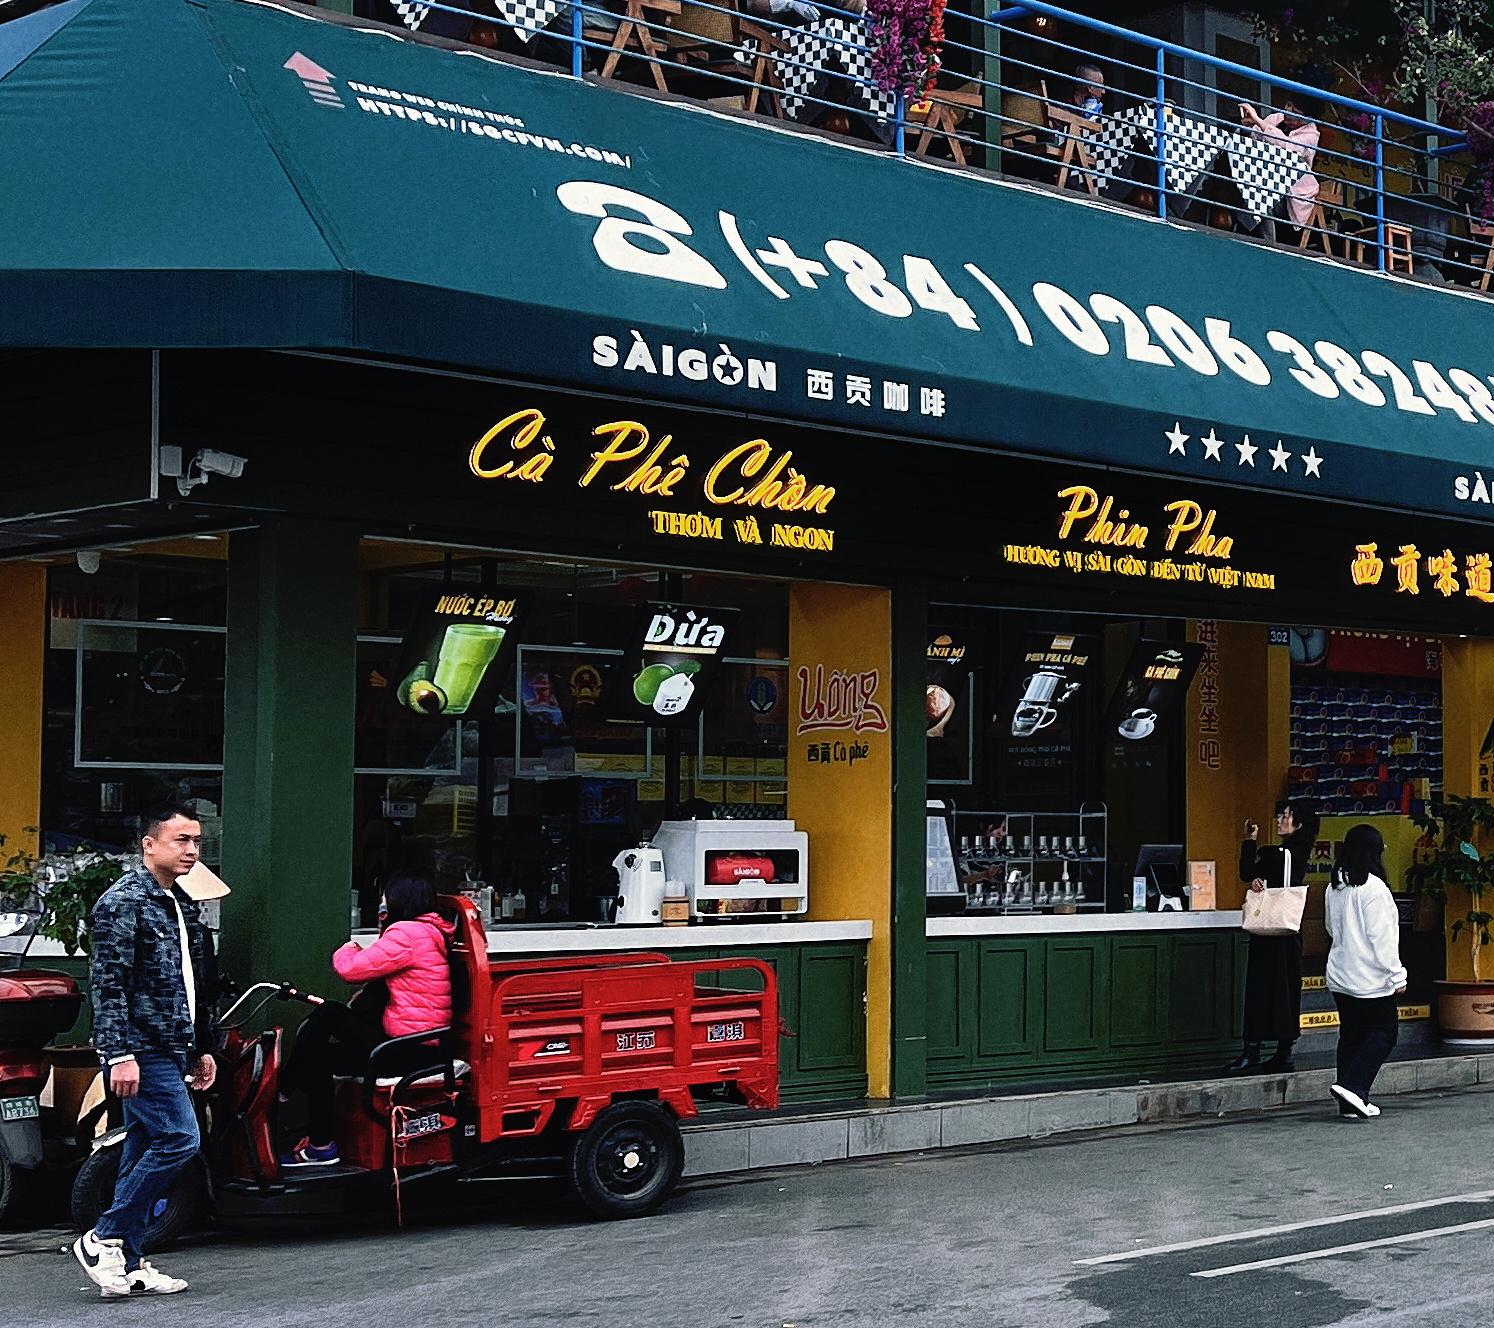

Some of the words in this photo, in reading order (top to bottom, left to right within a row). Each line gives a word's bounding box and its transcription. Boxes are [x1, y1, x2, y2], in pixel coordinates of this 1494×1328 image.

[718, 209, 1034, 347] (+84)
[1033, 281, 1272, 387] 0206
[592, 329, 777, 393] SÀIGÒN
[806, 368, 946, 419] 西贡咖啡
[469, 408, 556, 483] Cà
[578, 420, 690, 497] Phê
[648, 510, 723, 541] THƠM
[734, 515, 761, 545] VÀ
[770, 523, 835, 552] NGON
[1056, 485, 1149, 550] Phin
[1163, 498, 1233, 561] Pha
[1004, 544, 1061, 568] HƯƠNG
[1064, 550, 1083, 573] VỊ
[1086, 550, 1111, 572] SÀI
[1114, 554, 1147, 576] GÒN
[1243, 571, 1275, 590] NAM
[644, 610, 725, 648] Dừa
[1269, 630, 1288, 643] 302
[797, 663, 888, 736] Uống
